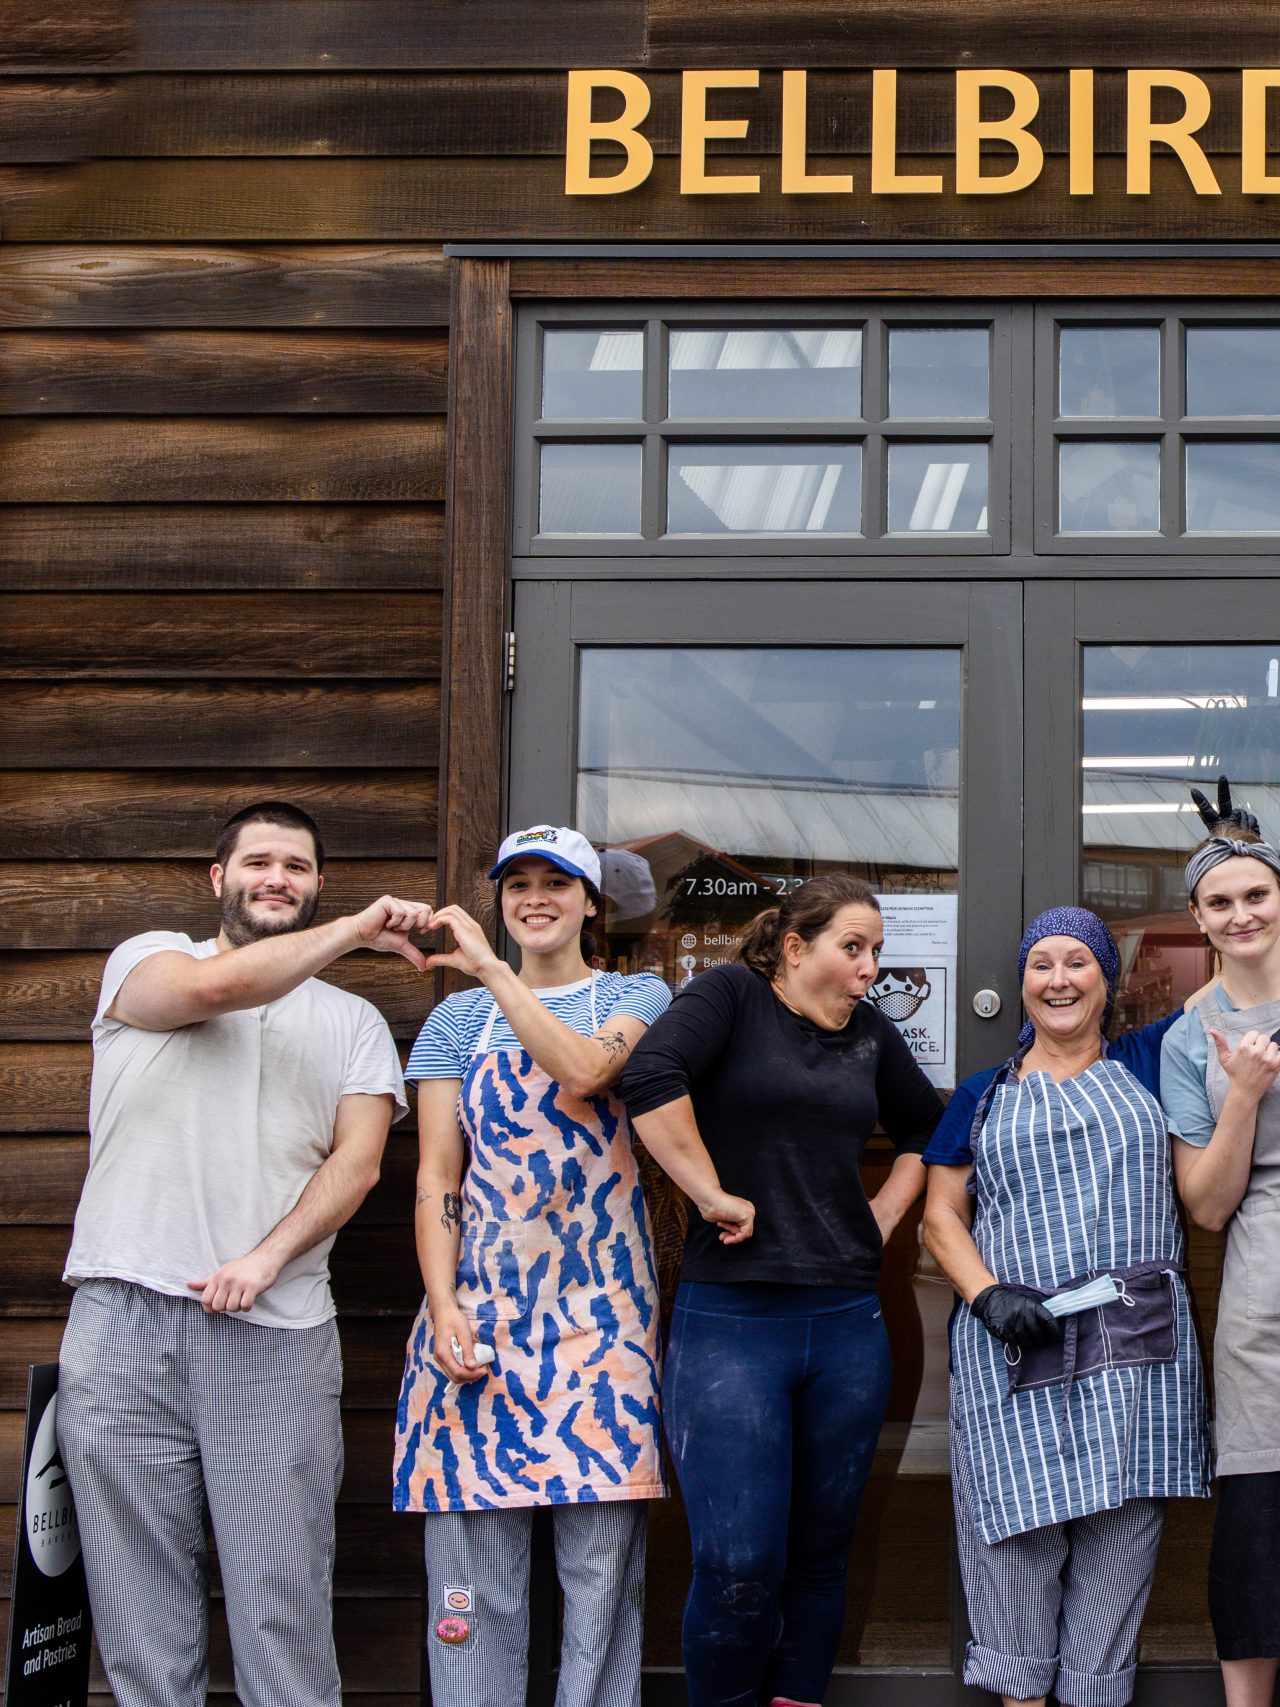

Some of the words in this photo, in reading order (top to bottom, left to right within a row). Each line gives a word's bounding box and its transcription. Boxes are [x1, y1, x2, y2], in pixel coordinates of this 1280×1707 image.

[686, 878, 757, 895] 7.30am
[902, 1028, 930, 1039] ASK.
[909, 1041, 940, 1052] VICE.
[33, 1507, 72, 1534] BELLBI
[22, 1623, 55, 1650] Artisan
[57, 1609, 82, 1637] Bread
[23, 1650, 41, 1676] and
[43, 1641, 77, 1669] Pastries
